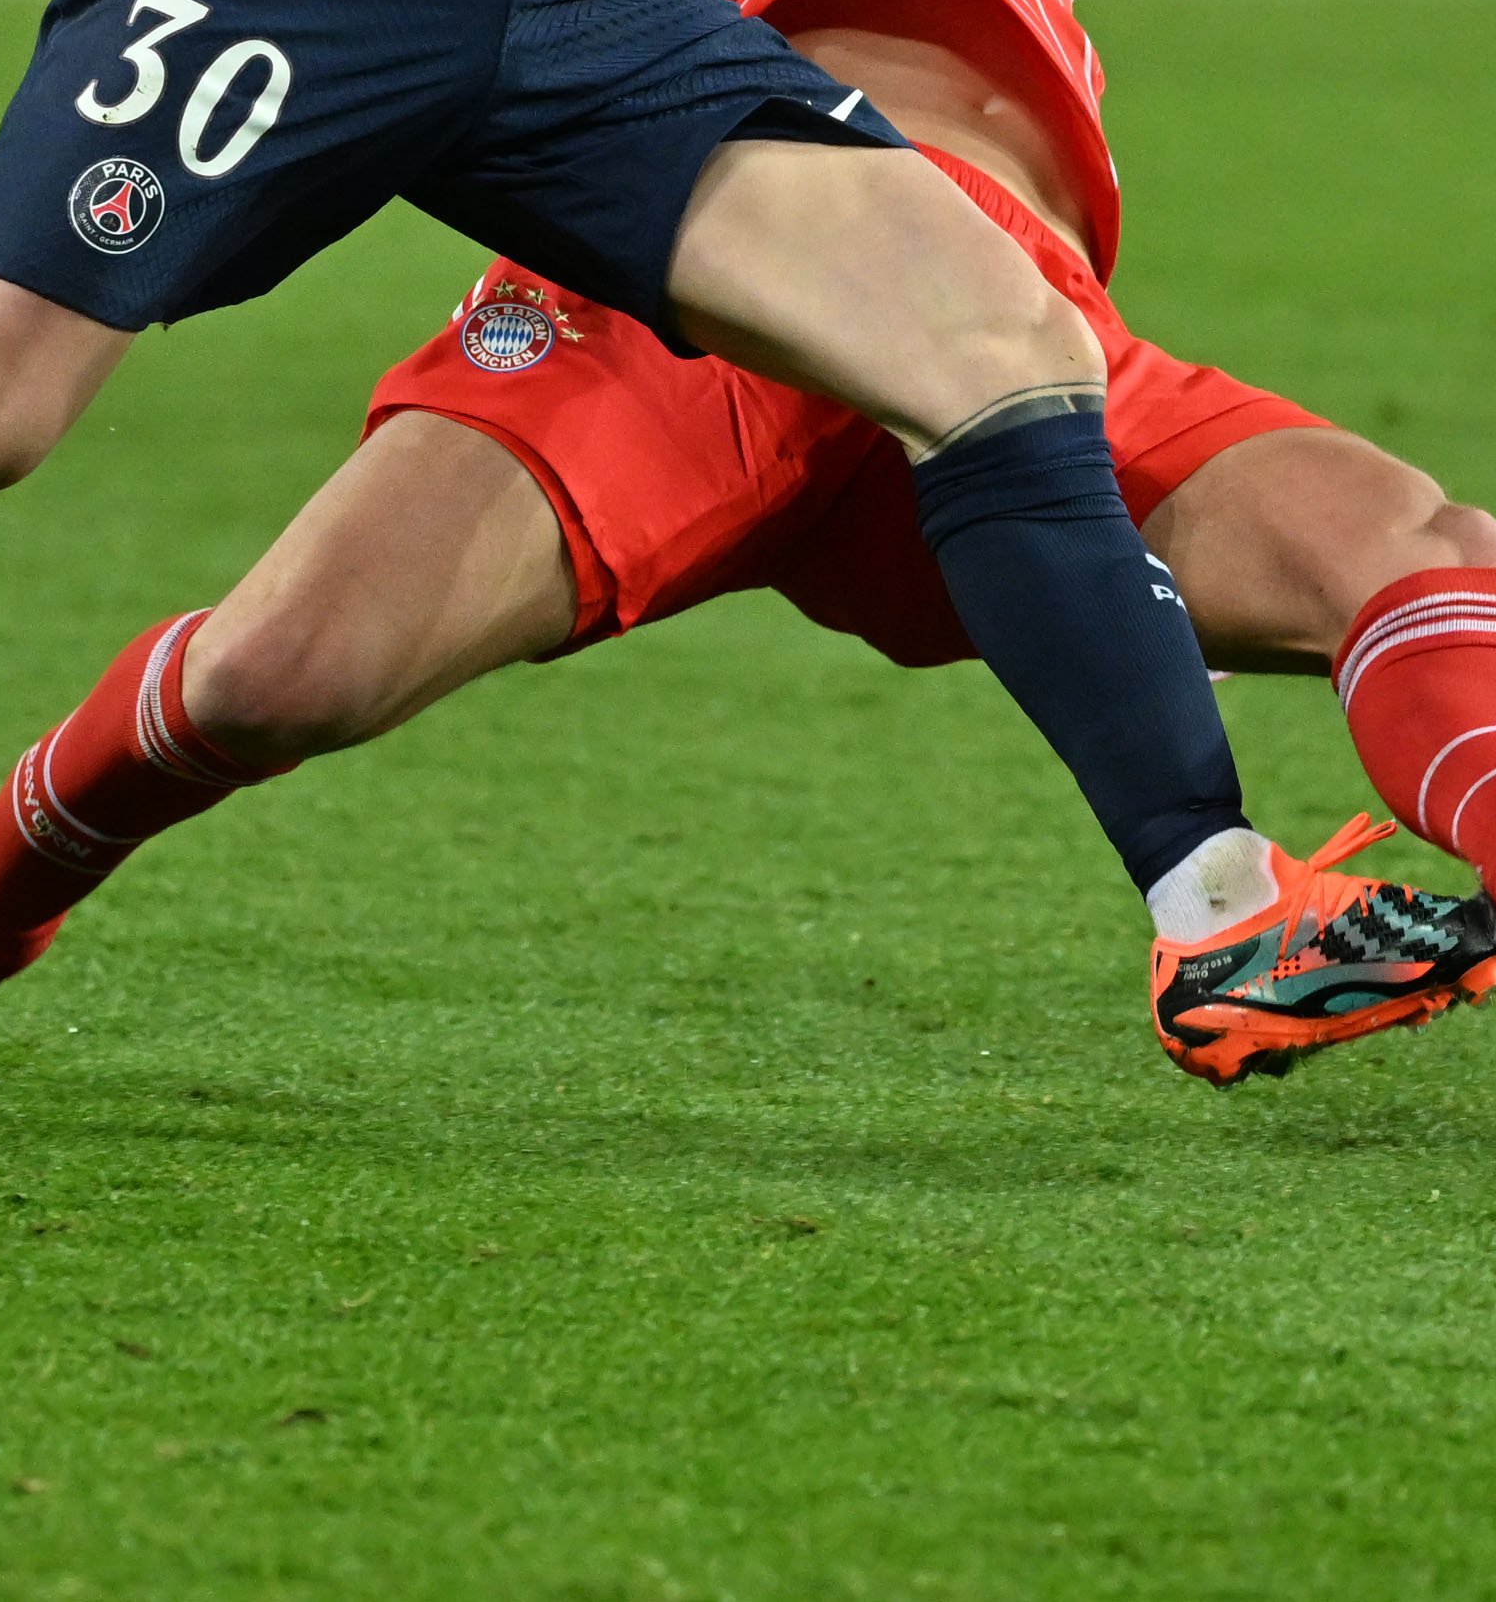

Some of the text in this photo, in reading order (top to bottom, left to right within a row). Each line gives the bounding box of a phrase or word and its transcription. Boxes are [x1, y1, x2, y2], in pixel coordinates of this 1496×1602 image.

[101, 163, 159, 200] PARIS
[79, 212, 135, 246] SAINT GERMAIN
[477, 307, 548, 341] FC BAYERN
